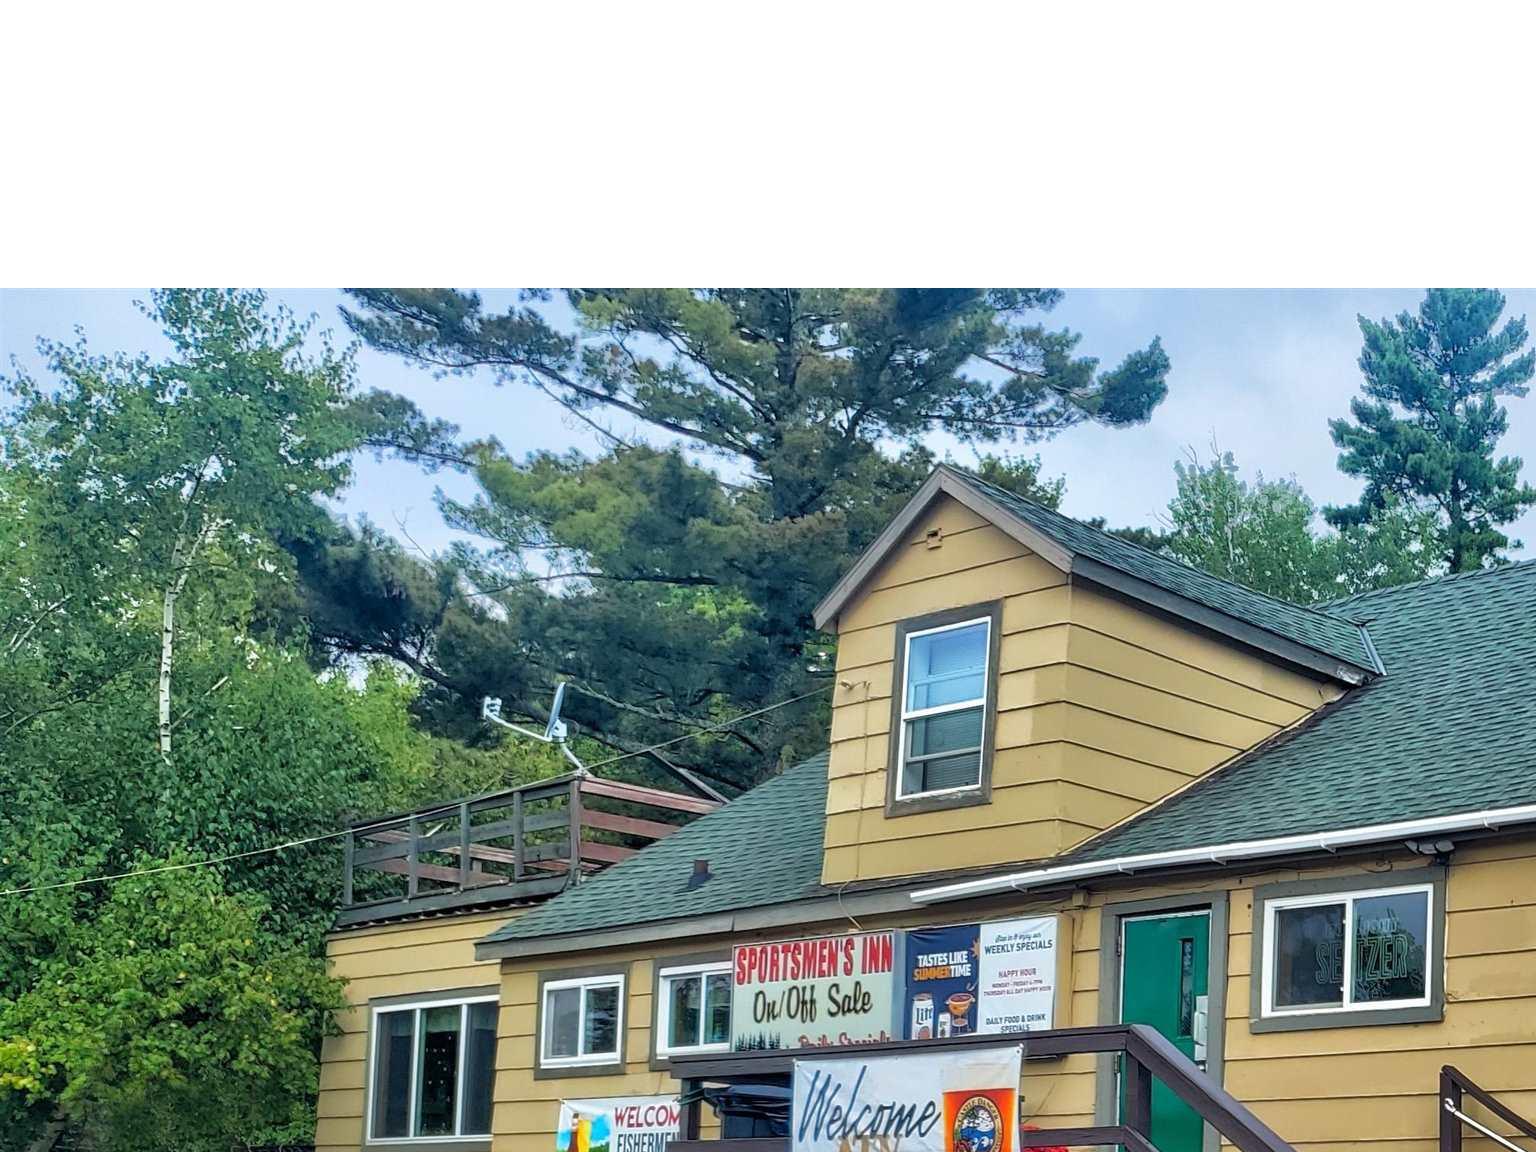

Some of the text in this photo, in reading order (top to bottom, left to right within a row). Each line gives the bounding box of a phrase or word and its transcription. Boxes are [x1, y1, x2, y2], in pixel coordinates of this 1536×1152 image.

[985, 939, 1053, 955] WEEKLY SPECIALS
[736, 934, 893, 985] SPORTSMEN'S INN
[917, 951, 968, 967] TASTES LIKE
[1315, 934, 1407, 985] SETZER
[998, 968, 1036, 978] HAPPY HOUR
[827, 981, 873, 1017] Sale
[986, 1017, 1003, 1025] DAILY
[1004, 1016, 1020, 1024] FOOD
[1027, 1013, 1046, 1022] DRINK
[1001, 1024, 1030, 1033] SPECIALS
[799, 1065, 942, 1144] Welcome
[614, 1105, 681, 1128] WELCOM
